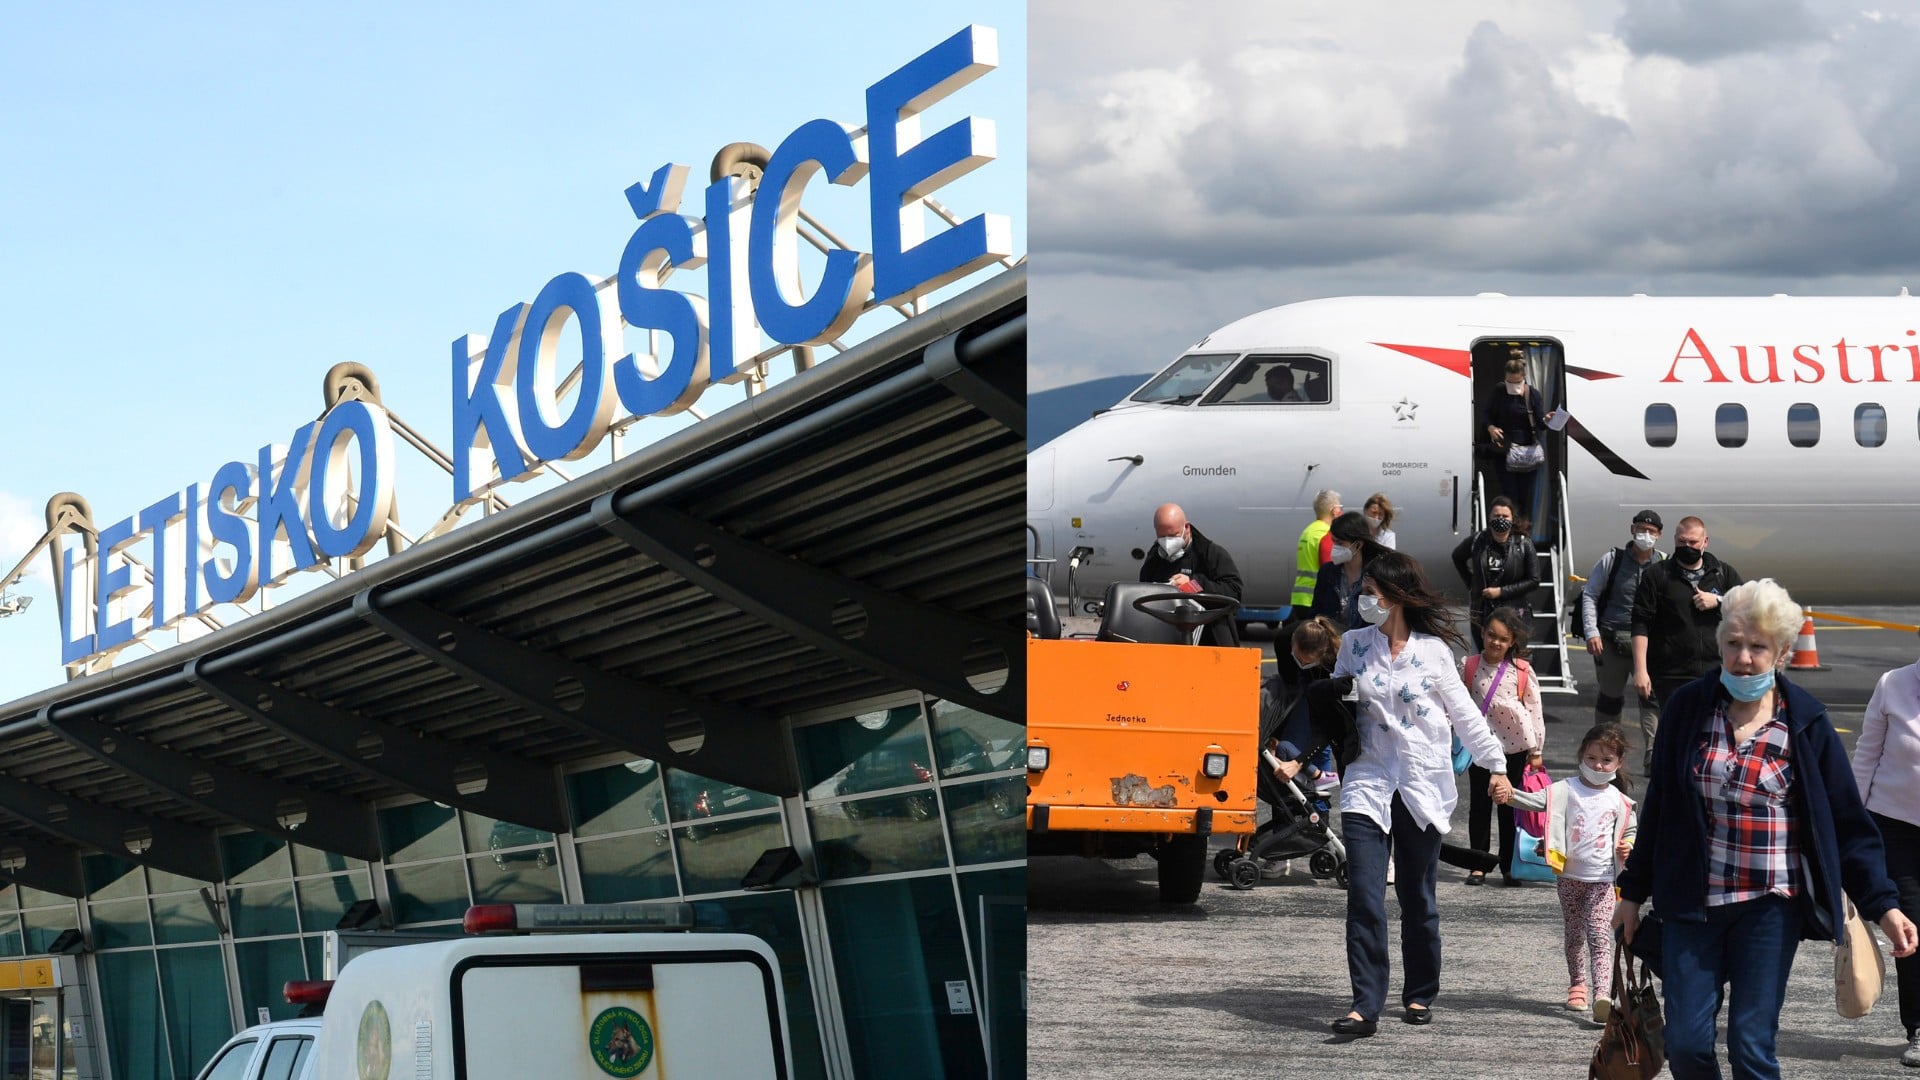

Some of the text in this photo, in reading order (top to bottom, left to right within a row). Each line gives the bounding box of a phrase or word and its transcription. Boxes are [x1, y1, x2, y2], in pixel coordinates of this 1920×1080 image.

[62, 24, 1010, 667] LETISKO KOŠICE
[1182, 465, 1237, 476] Gmunden
[1106, 713, 1147, 723] Jednotka
